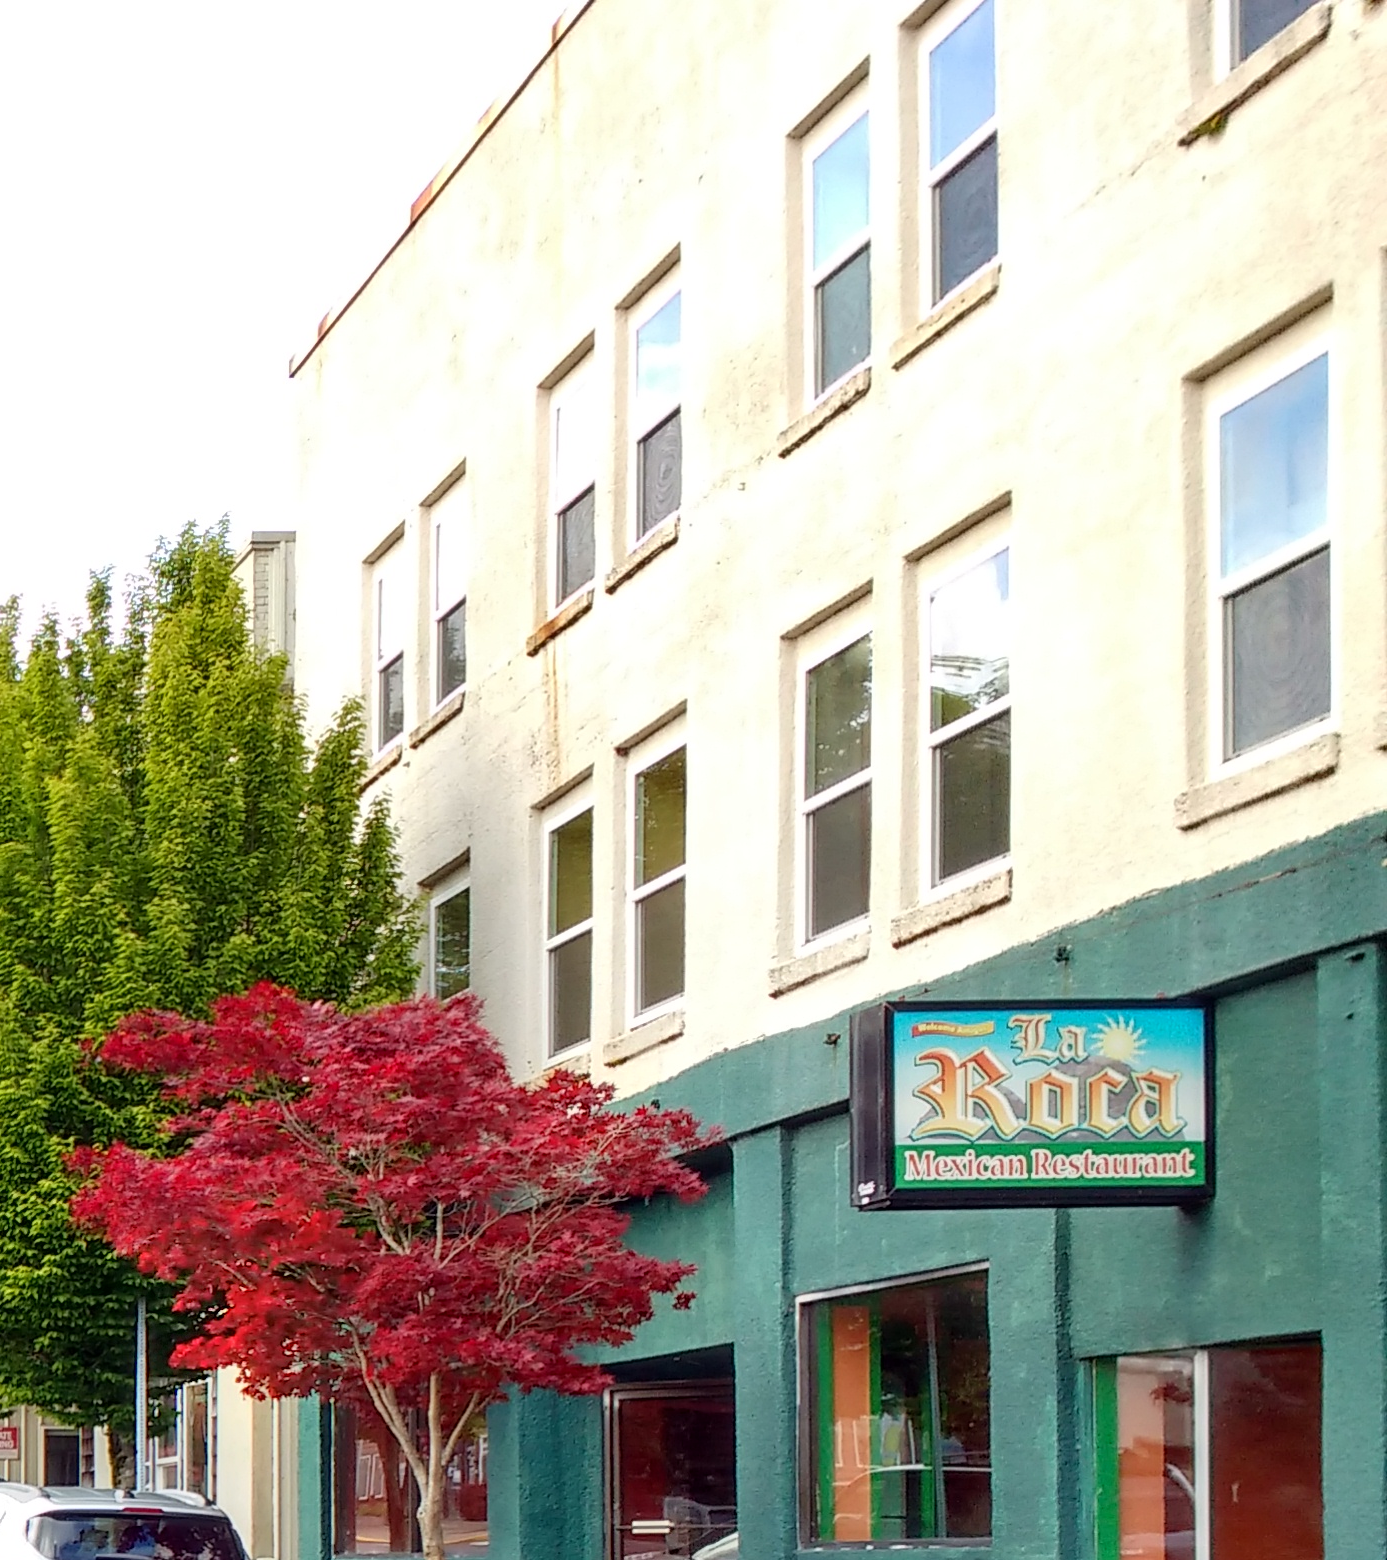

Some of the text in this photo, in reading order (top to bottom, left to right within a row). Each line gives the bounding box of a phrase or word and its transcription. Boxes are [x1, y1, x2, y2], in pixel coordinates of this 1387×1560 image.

[1008, 1013, 1089, 1065] La
[910, 1047, 1187, 1142] Roca
[906, 1147, 1195, 1180] Mexican Restaurant
